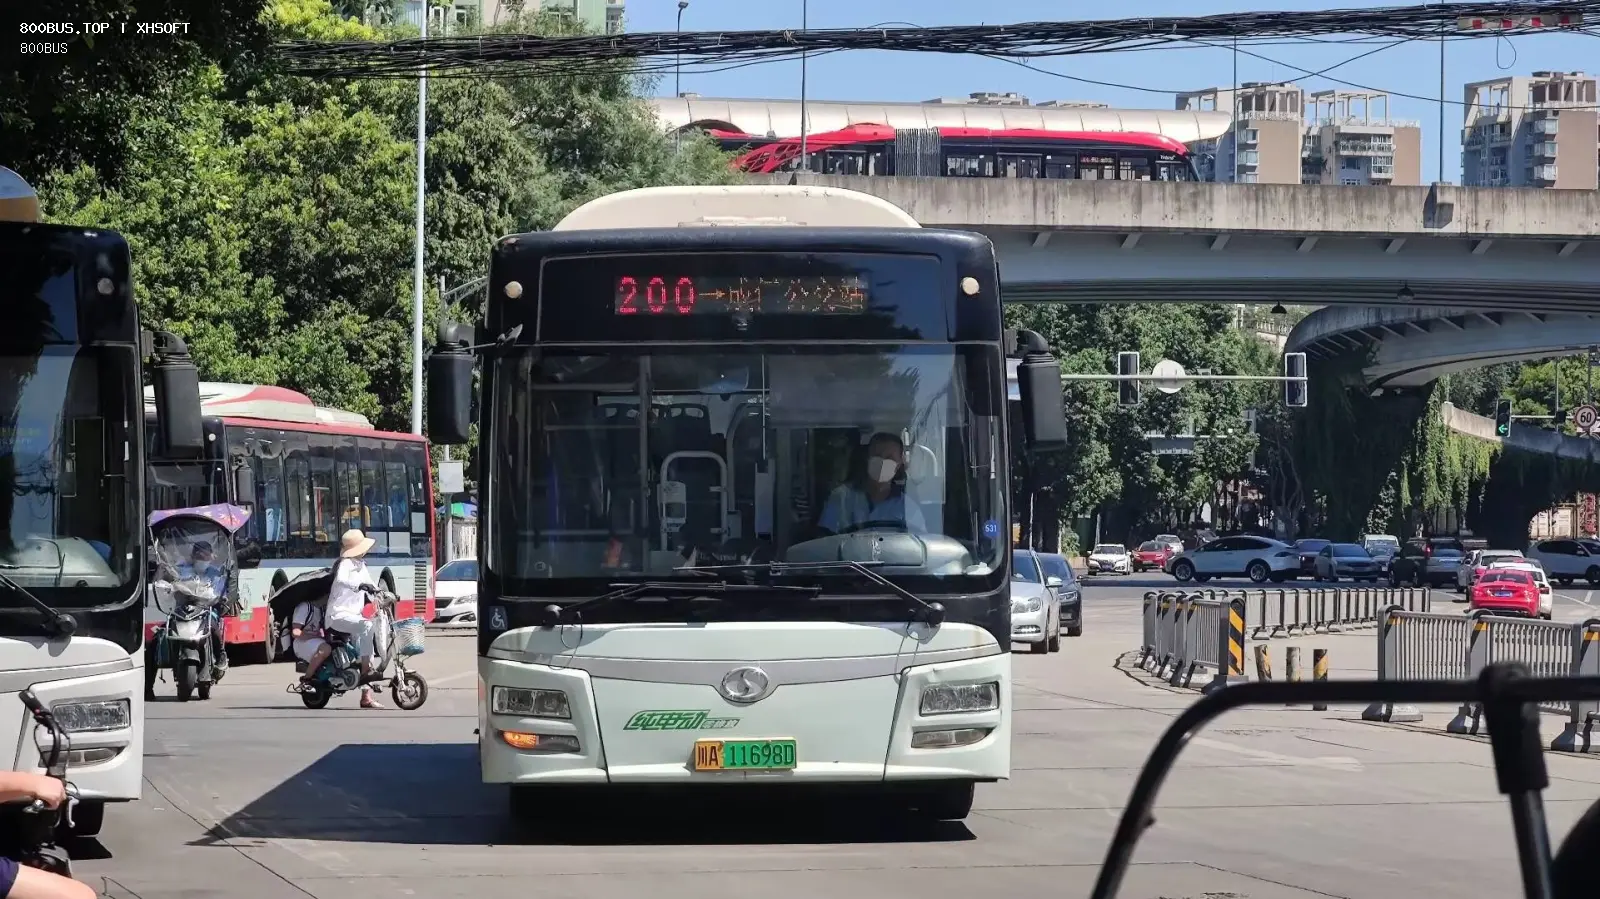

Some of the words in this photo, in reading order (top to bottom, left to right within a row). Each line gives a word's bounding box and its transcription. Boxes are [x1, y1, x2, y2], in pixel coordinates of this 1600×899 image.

[618, 276, 696, 314] 200
[1580, 411, 1592, 423] 60
[985, 524, 997, 533] 531
[629, 711, 708, 731] 纯电动
[729, 743, 795, 766] 11698D
